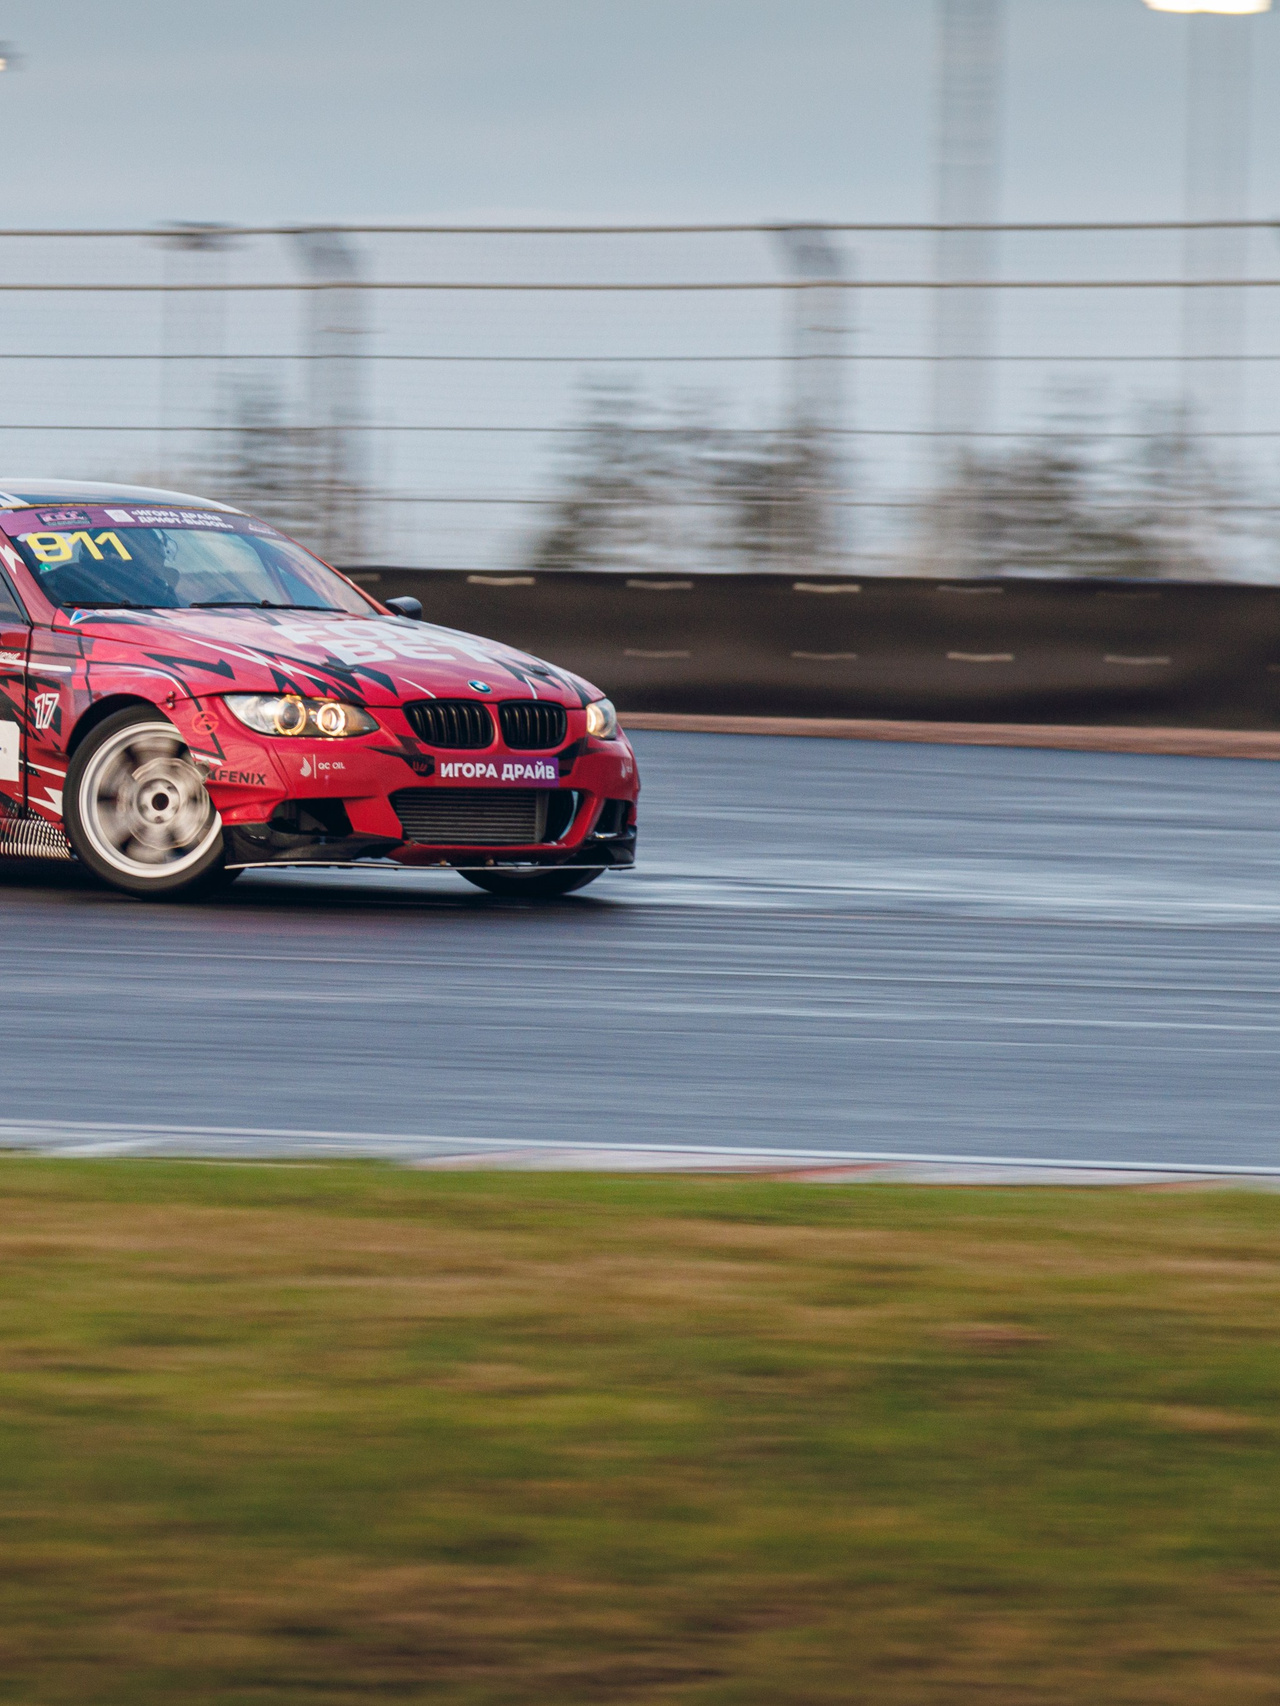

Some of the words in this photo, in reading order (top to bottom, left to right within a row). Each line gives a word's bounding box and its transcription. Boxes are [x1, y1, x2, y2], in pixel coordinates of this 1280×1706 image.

[25, 531, 133, 562] 911
[319, 640, 495, 666] BET
[34, 693, 60, 729] 17
[219, 770, 267, 786] FENIX
[440, 762, 498, 779] ИГОРА
[501, 761, 556, 781] ДРАЙВ
